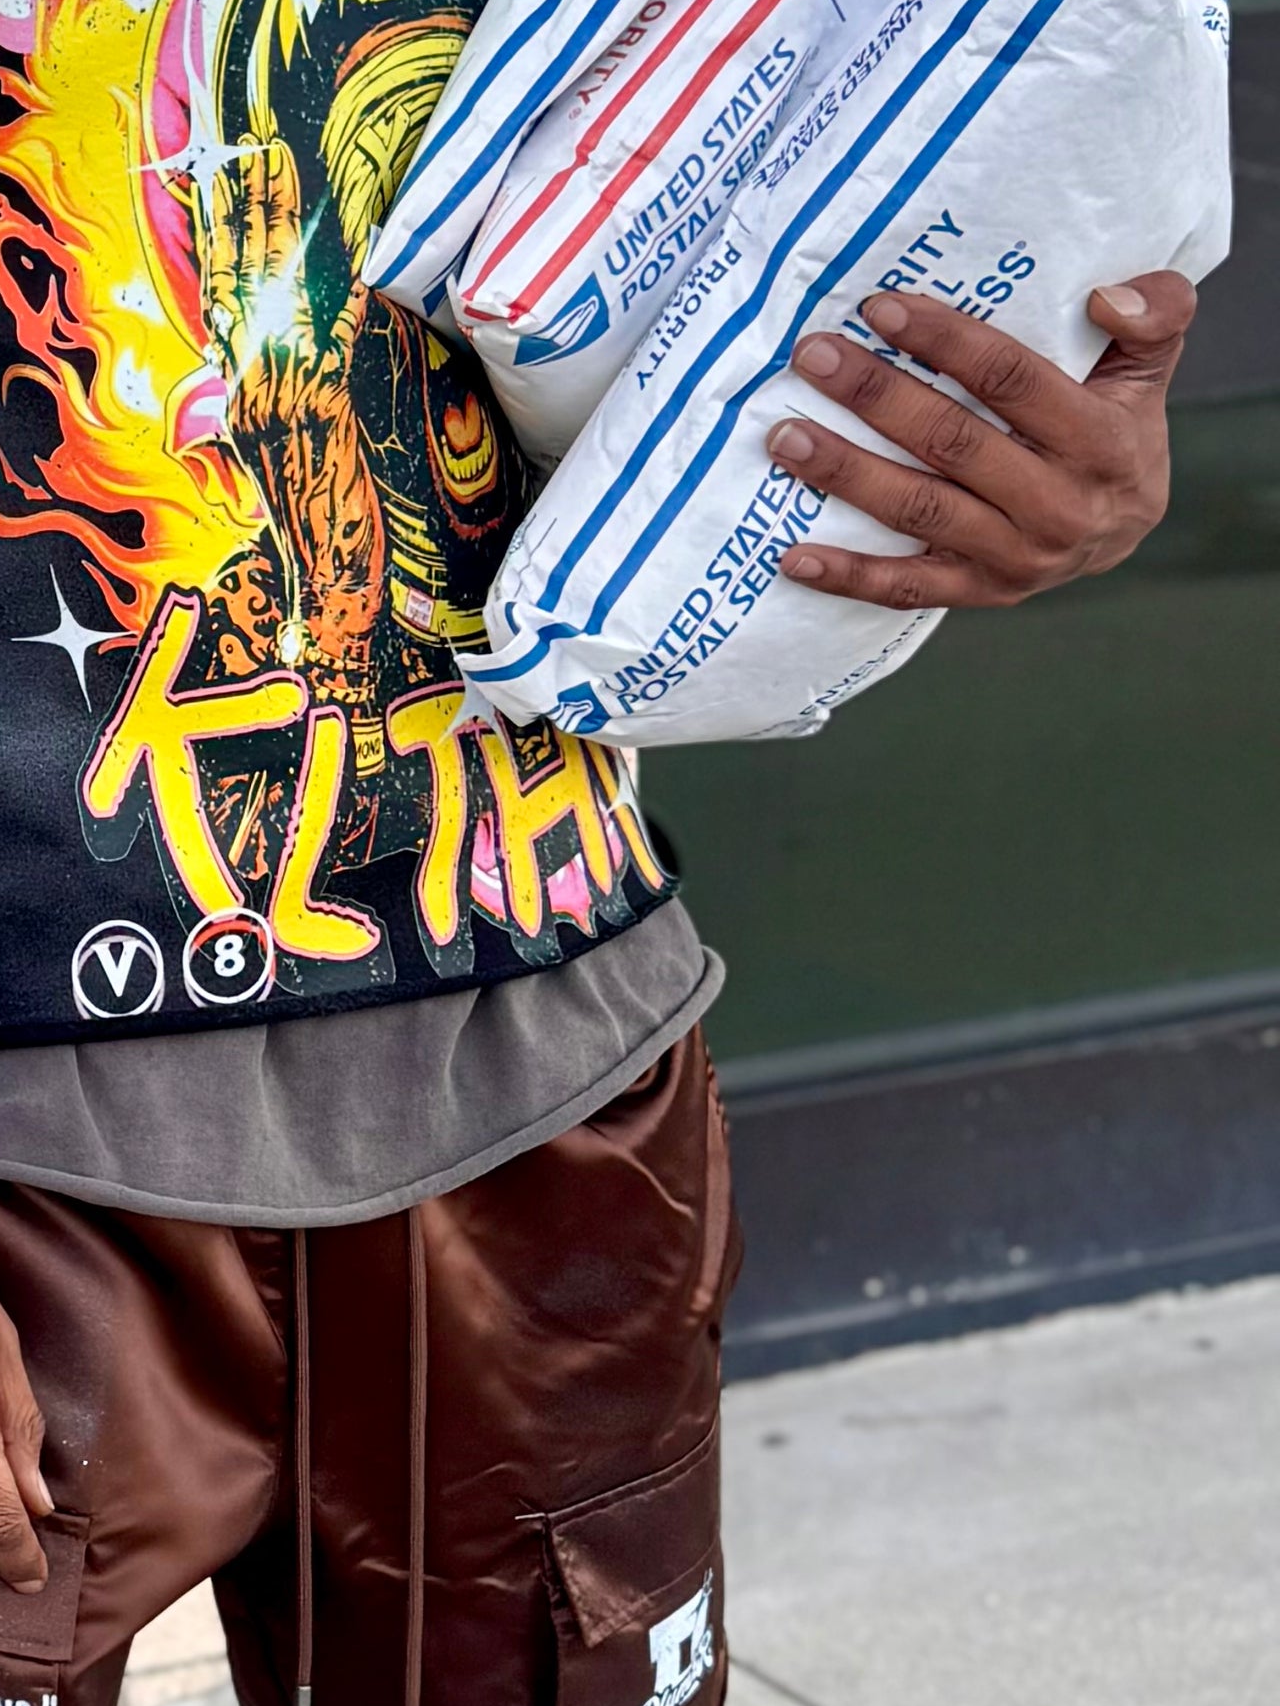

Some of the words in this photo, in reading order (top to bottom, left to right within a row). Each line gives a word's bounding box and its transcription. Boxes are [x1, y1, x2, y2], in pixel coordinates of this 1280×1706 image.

[841, 0, 924, 101] UNITED
[604, 153, 706, 277] UNITED
[702, 36, 797, 163] STATES
[621, 195, 723, 313] POSTAL
[636, 240, 743, 392] PRIORITY
[602, 587, 714, 695] UNITED
[705, 461, 797, 593] STATES
[616, 617, 739, 715] POSTAL
[90, 942, 141, 999] V
[213, 933, 247, 979] 8
